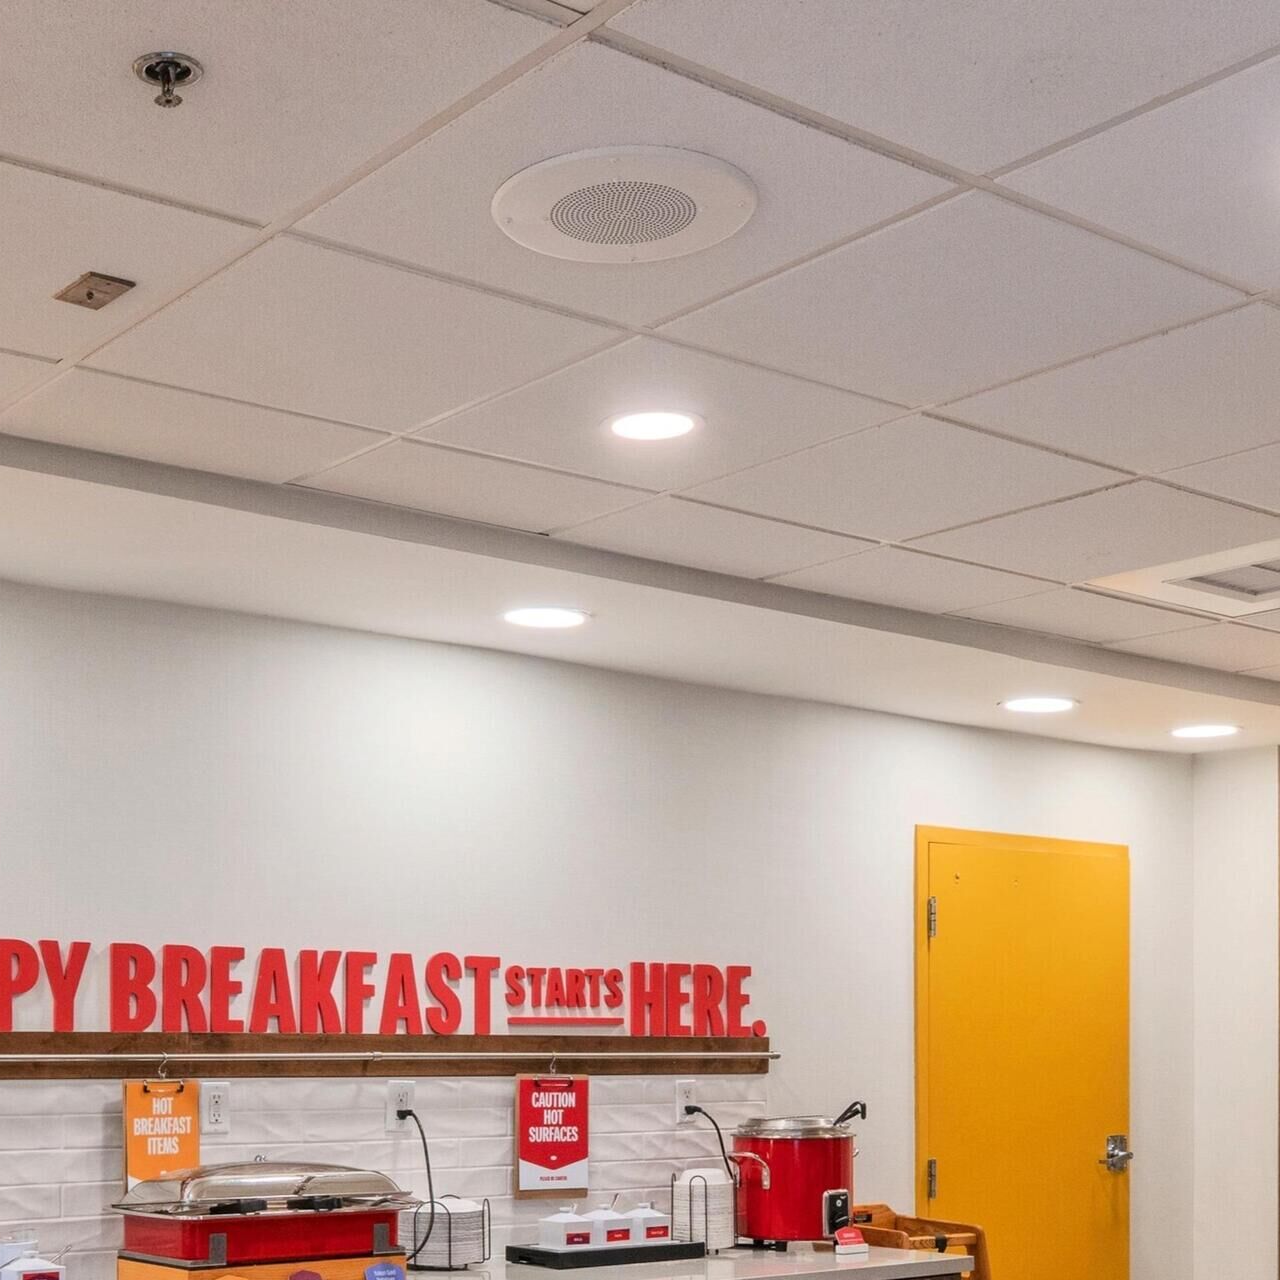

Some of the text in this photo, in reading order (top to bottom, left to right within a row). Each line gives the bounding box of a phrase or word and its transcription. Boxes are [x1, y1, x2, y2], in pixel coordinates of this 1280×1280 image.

[110, 942, 501, 1036] BREAKFAST
[504, 964, 624, 1009] STARTS
[630, 961, 767, 1038] HERE.
[152, 1097, 174, 1115] HOT
[531, 1092, 576, 1108] CAUTION
[133, 1116, 192, 1136] BREAKFAST
[543, 1109, 564, 1125] HOT
[528, 1126, 579, 1143] SURFACES
[147, 1136, 180, 1156] ITEMS
